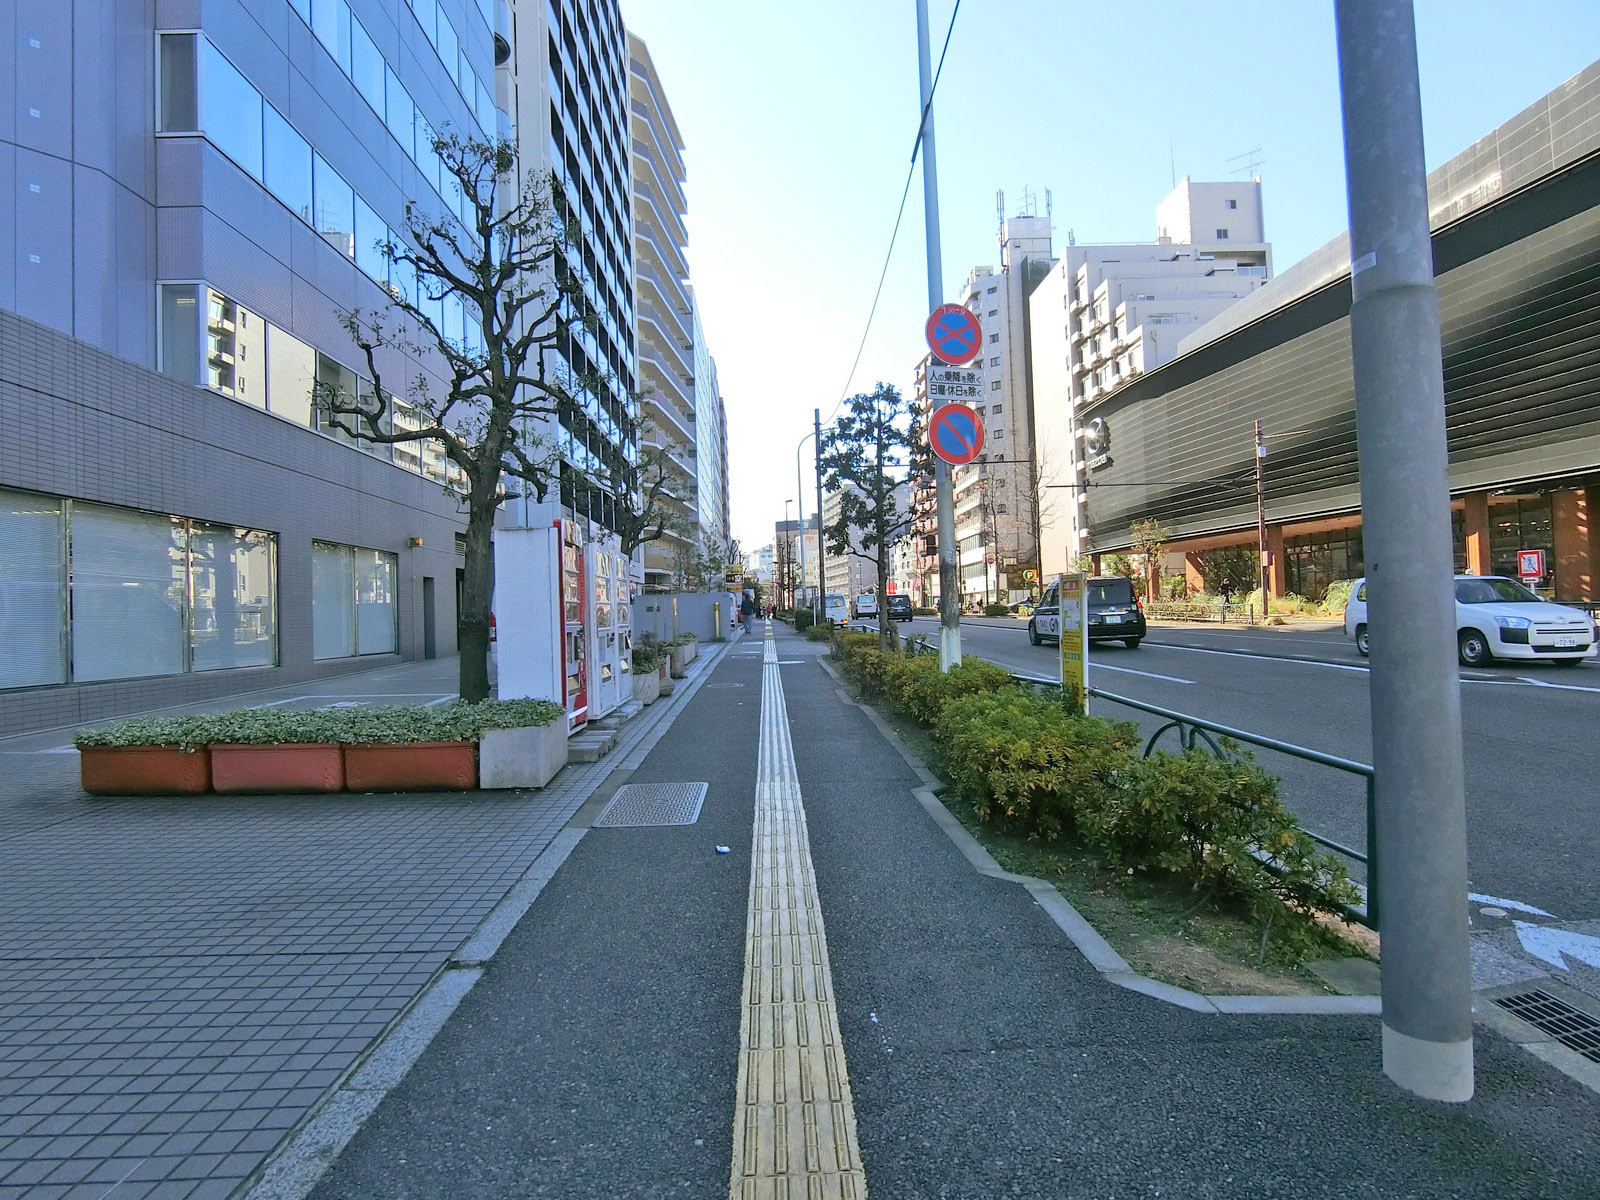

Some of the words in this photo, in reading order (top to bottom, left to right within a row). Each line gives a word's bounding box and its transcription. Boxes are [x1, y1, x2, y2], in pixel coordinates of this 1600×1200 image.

[930, 370, 981, 384] 人の乗降を除く
